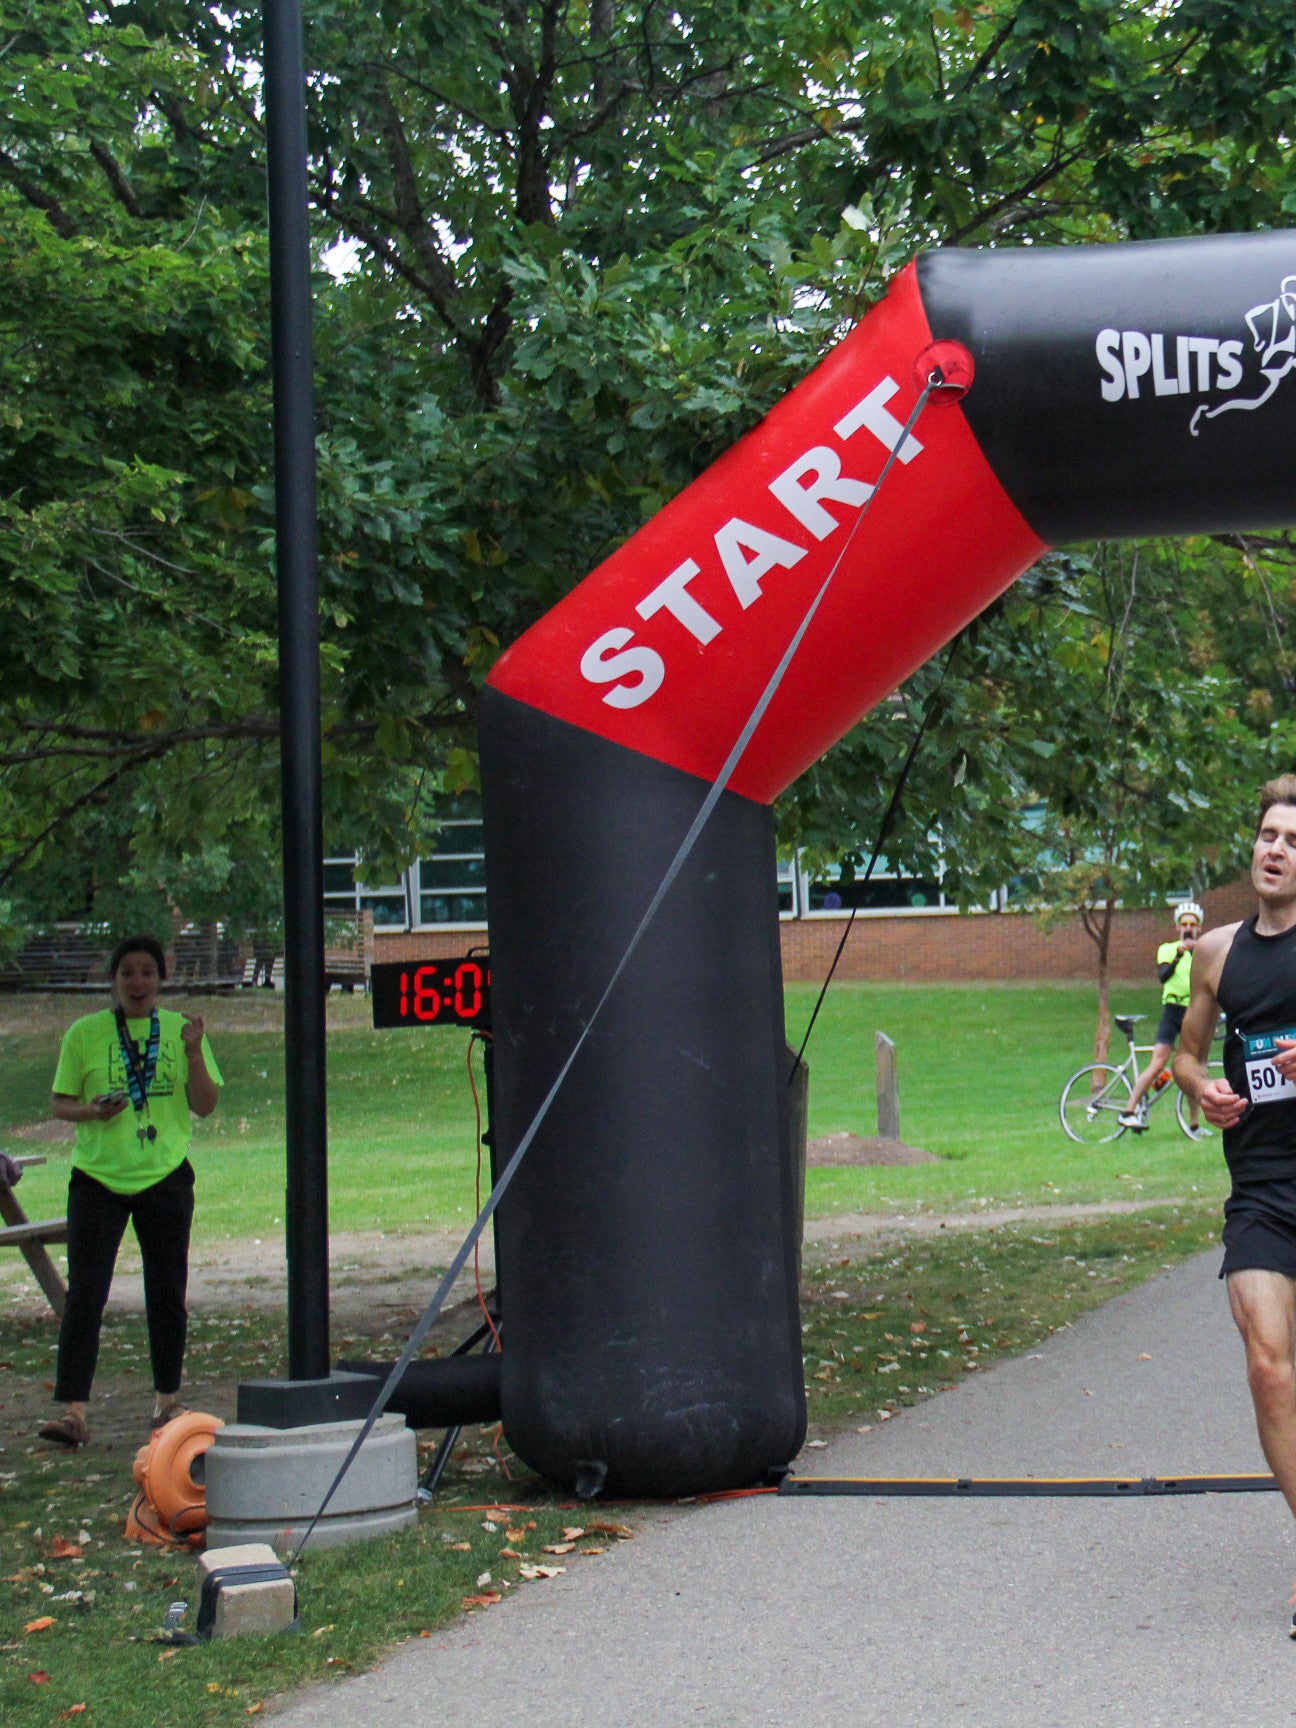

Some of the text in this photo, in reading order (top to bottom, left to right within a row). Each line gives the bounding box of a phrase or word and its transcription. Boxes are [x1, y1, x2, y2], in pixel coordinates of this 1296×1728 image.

[1094, 327, 1245, 403] SPLITS
[580, 375, 925, 710] START
[399, 962, 491, 1021] 16:0
